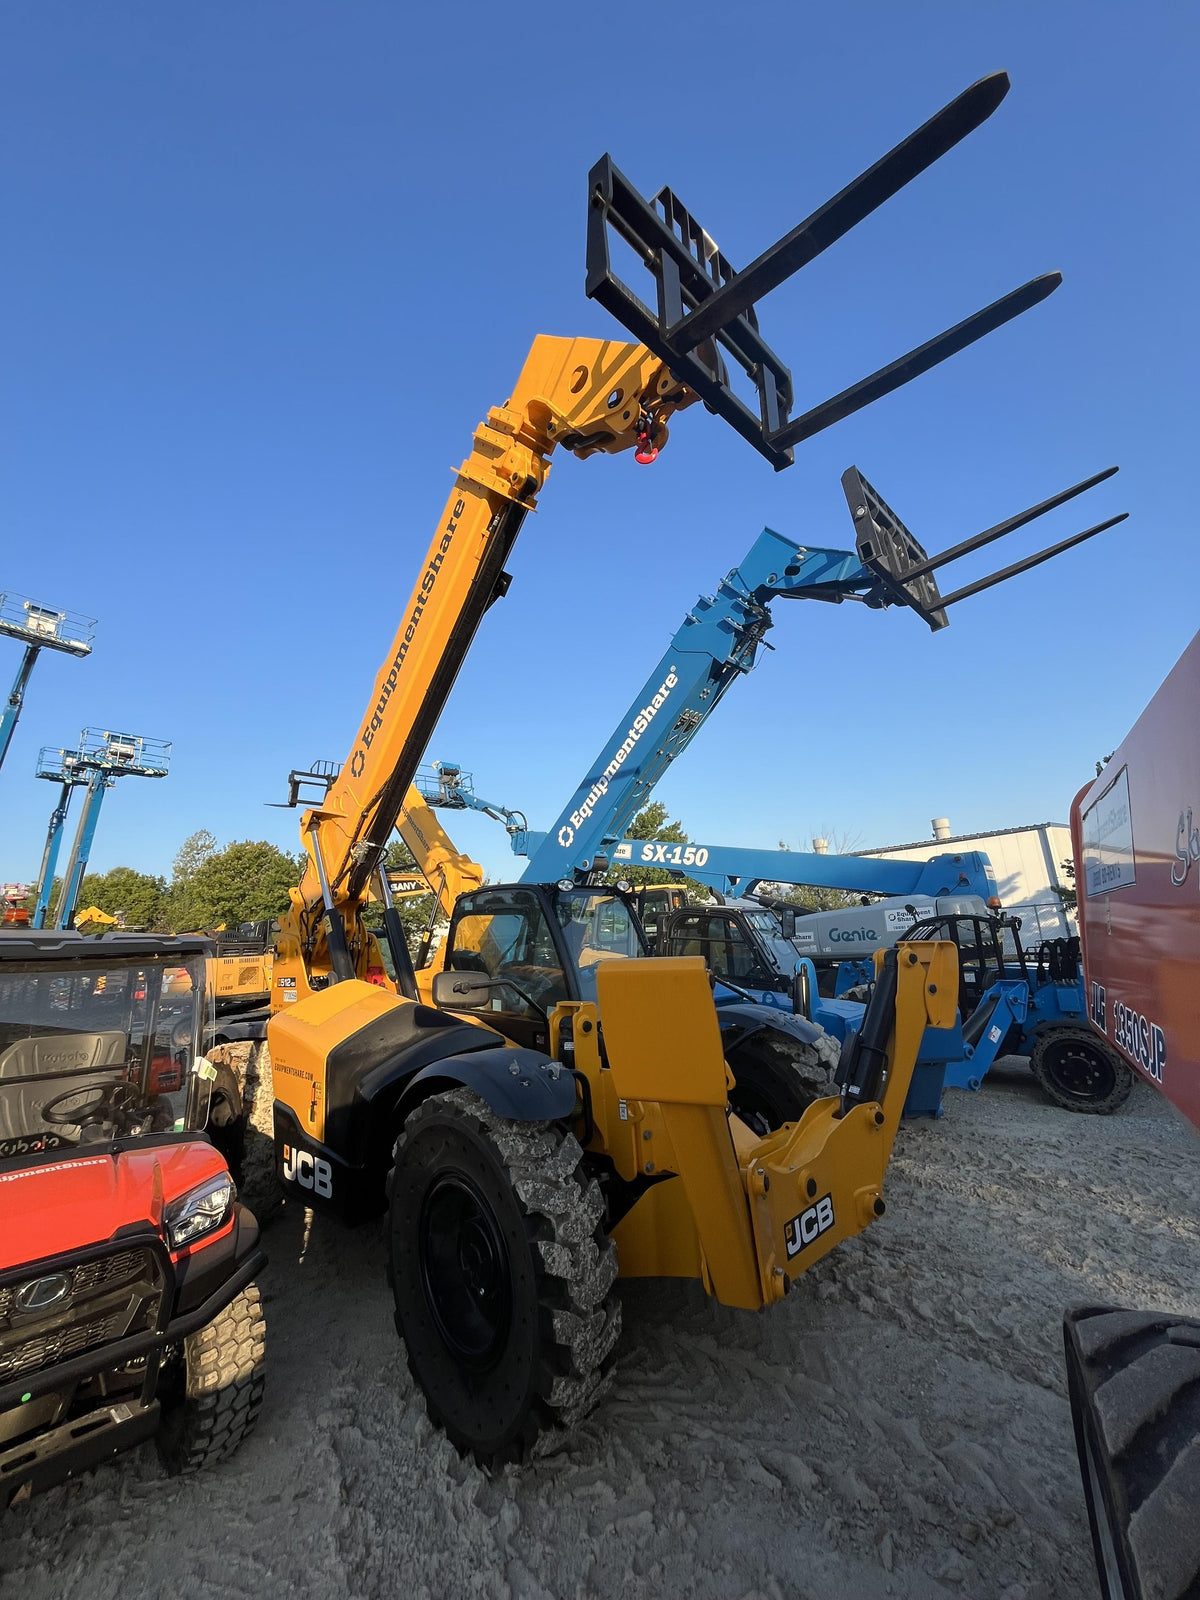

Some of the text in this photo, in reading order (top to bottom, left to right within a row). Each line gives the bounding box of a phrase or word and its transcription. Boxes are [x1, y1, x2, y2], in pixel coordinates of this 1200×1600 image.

[362, 498, 466, 750] EquipmentShare
[569, 672, 679, 830] EquipmentShare
[641, 843, 709, 867] SX-150
[391, 880, 417, 891] SANY
[828, 926, 878, 943] Genie
[1114, 1000, 1168, 1085] 1350SJP
[284, 1147, 333, 1199] JCB
[787, 1197, 834, 1255] JCB
